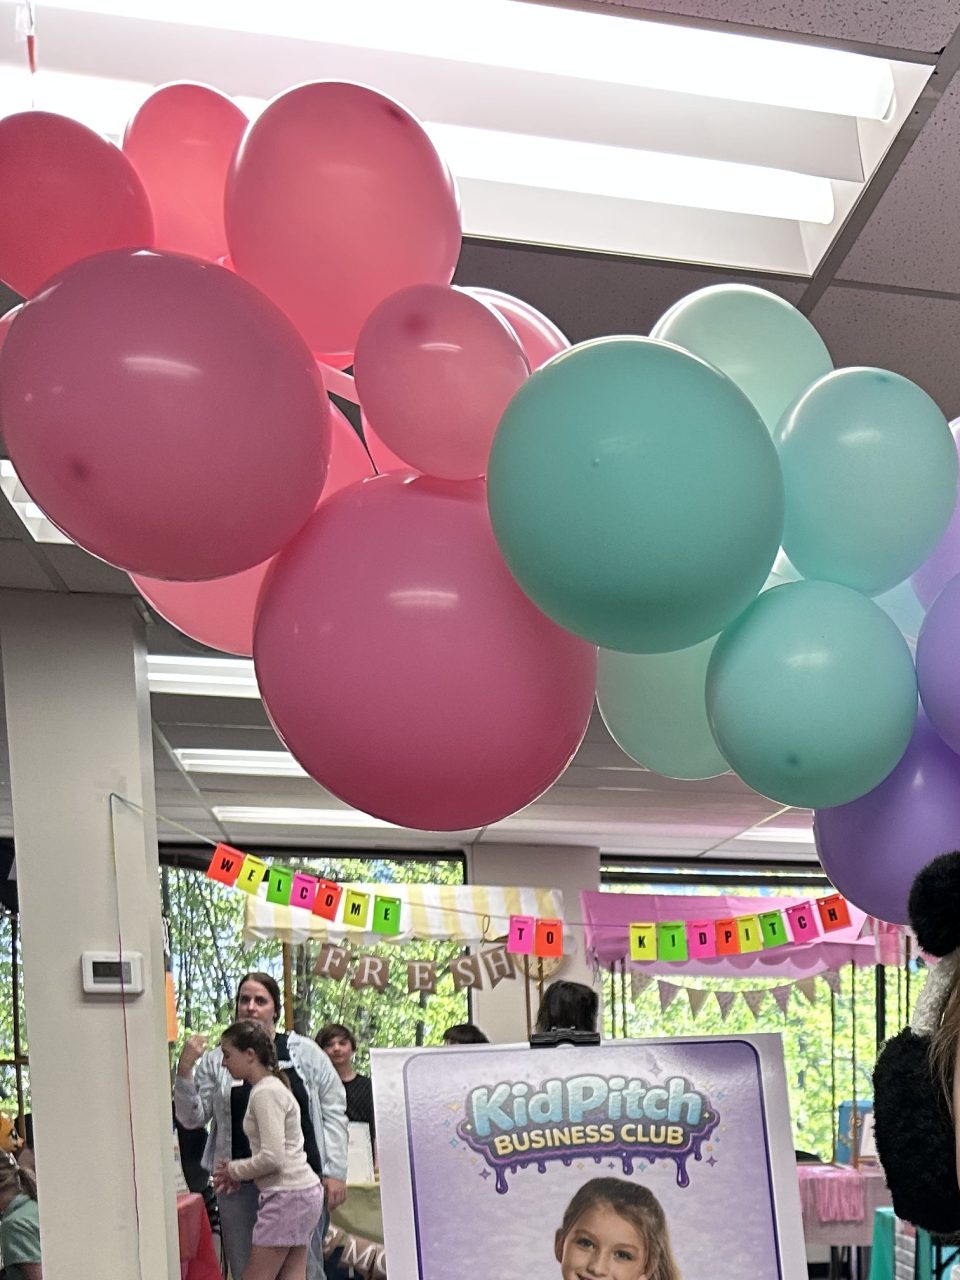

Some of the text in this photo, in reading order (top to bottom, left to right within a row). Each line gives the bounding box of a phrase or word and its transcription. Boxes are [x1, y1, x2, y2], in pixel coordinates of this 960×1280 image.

[220, 857, 838, 950] WELCOME TO KIDPITCH
[321, 948, 508, 990] FRESH
[471, 1076, 701, 1137] KidPitch
[494, 1123, 684, 1156] BUSINESS CLUB
